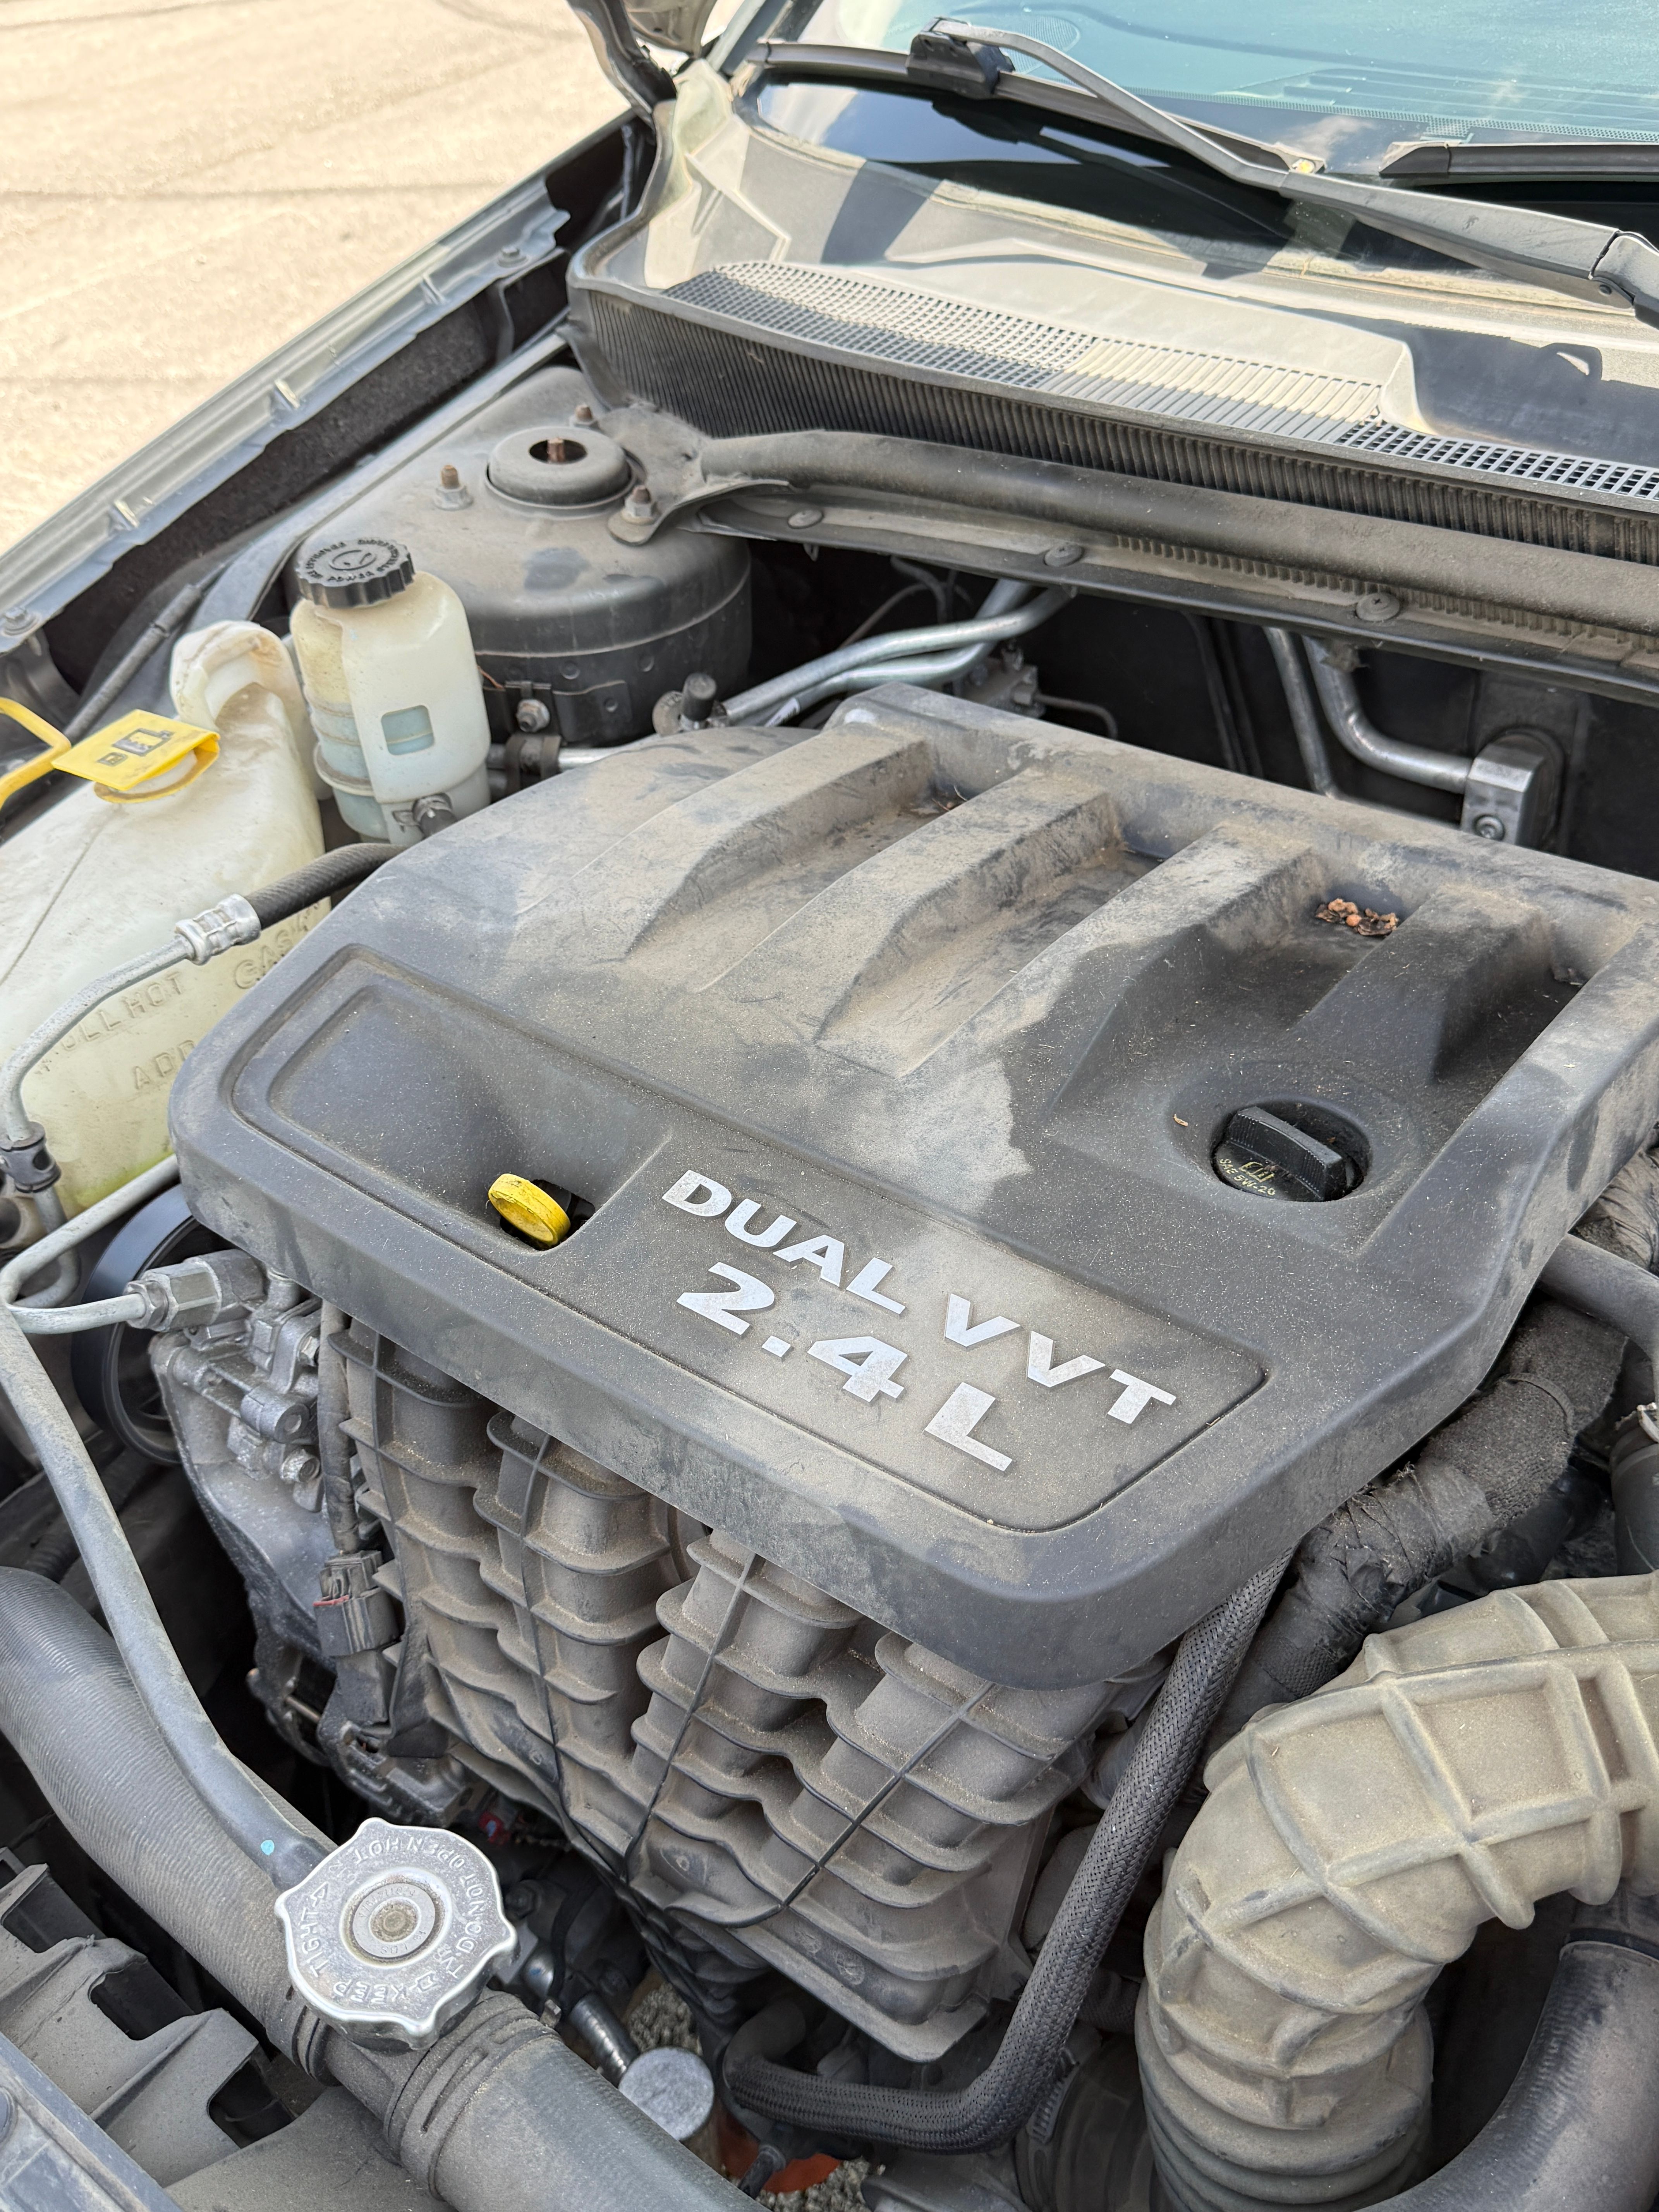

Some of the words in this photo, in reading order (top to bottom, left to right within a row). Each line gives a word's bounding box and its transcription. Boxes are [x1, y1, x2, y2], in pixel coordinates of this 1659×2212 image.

[122, 971, 183, 1018] HOT
[133, 1039, 195, 1090] ADD
[1219, 1159, 1238, 1174] SAE
[1234, 1175, 1276, 1195] 5W-20
[661, 1169, 907, 1316] DUAL
[943, 1293, 1177, 1425] VVT
[352, 1835, 399, 1865] HOT
[407, 1836, 465, 1869] OPEN
[459, 1873, 485, 1917] NOT
[300, 1906, 330, 1977] TIGHT
[456, 1921, 482, 1953] DO
[333, 1978, 405, 2003] KEEP
